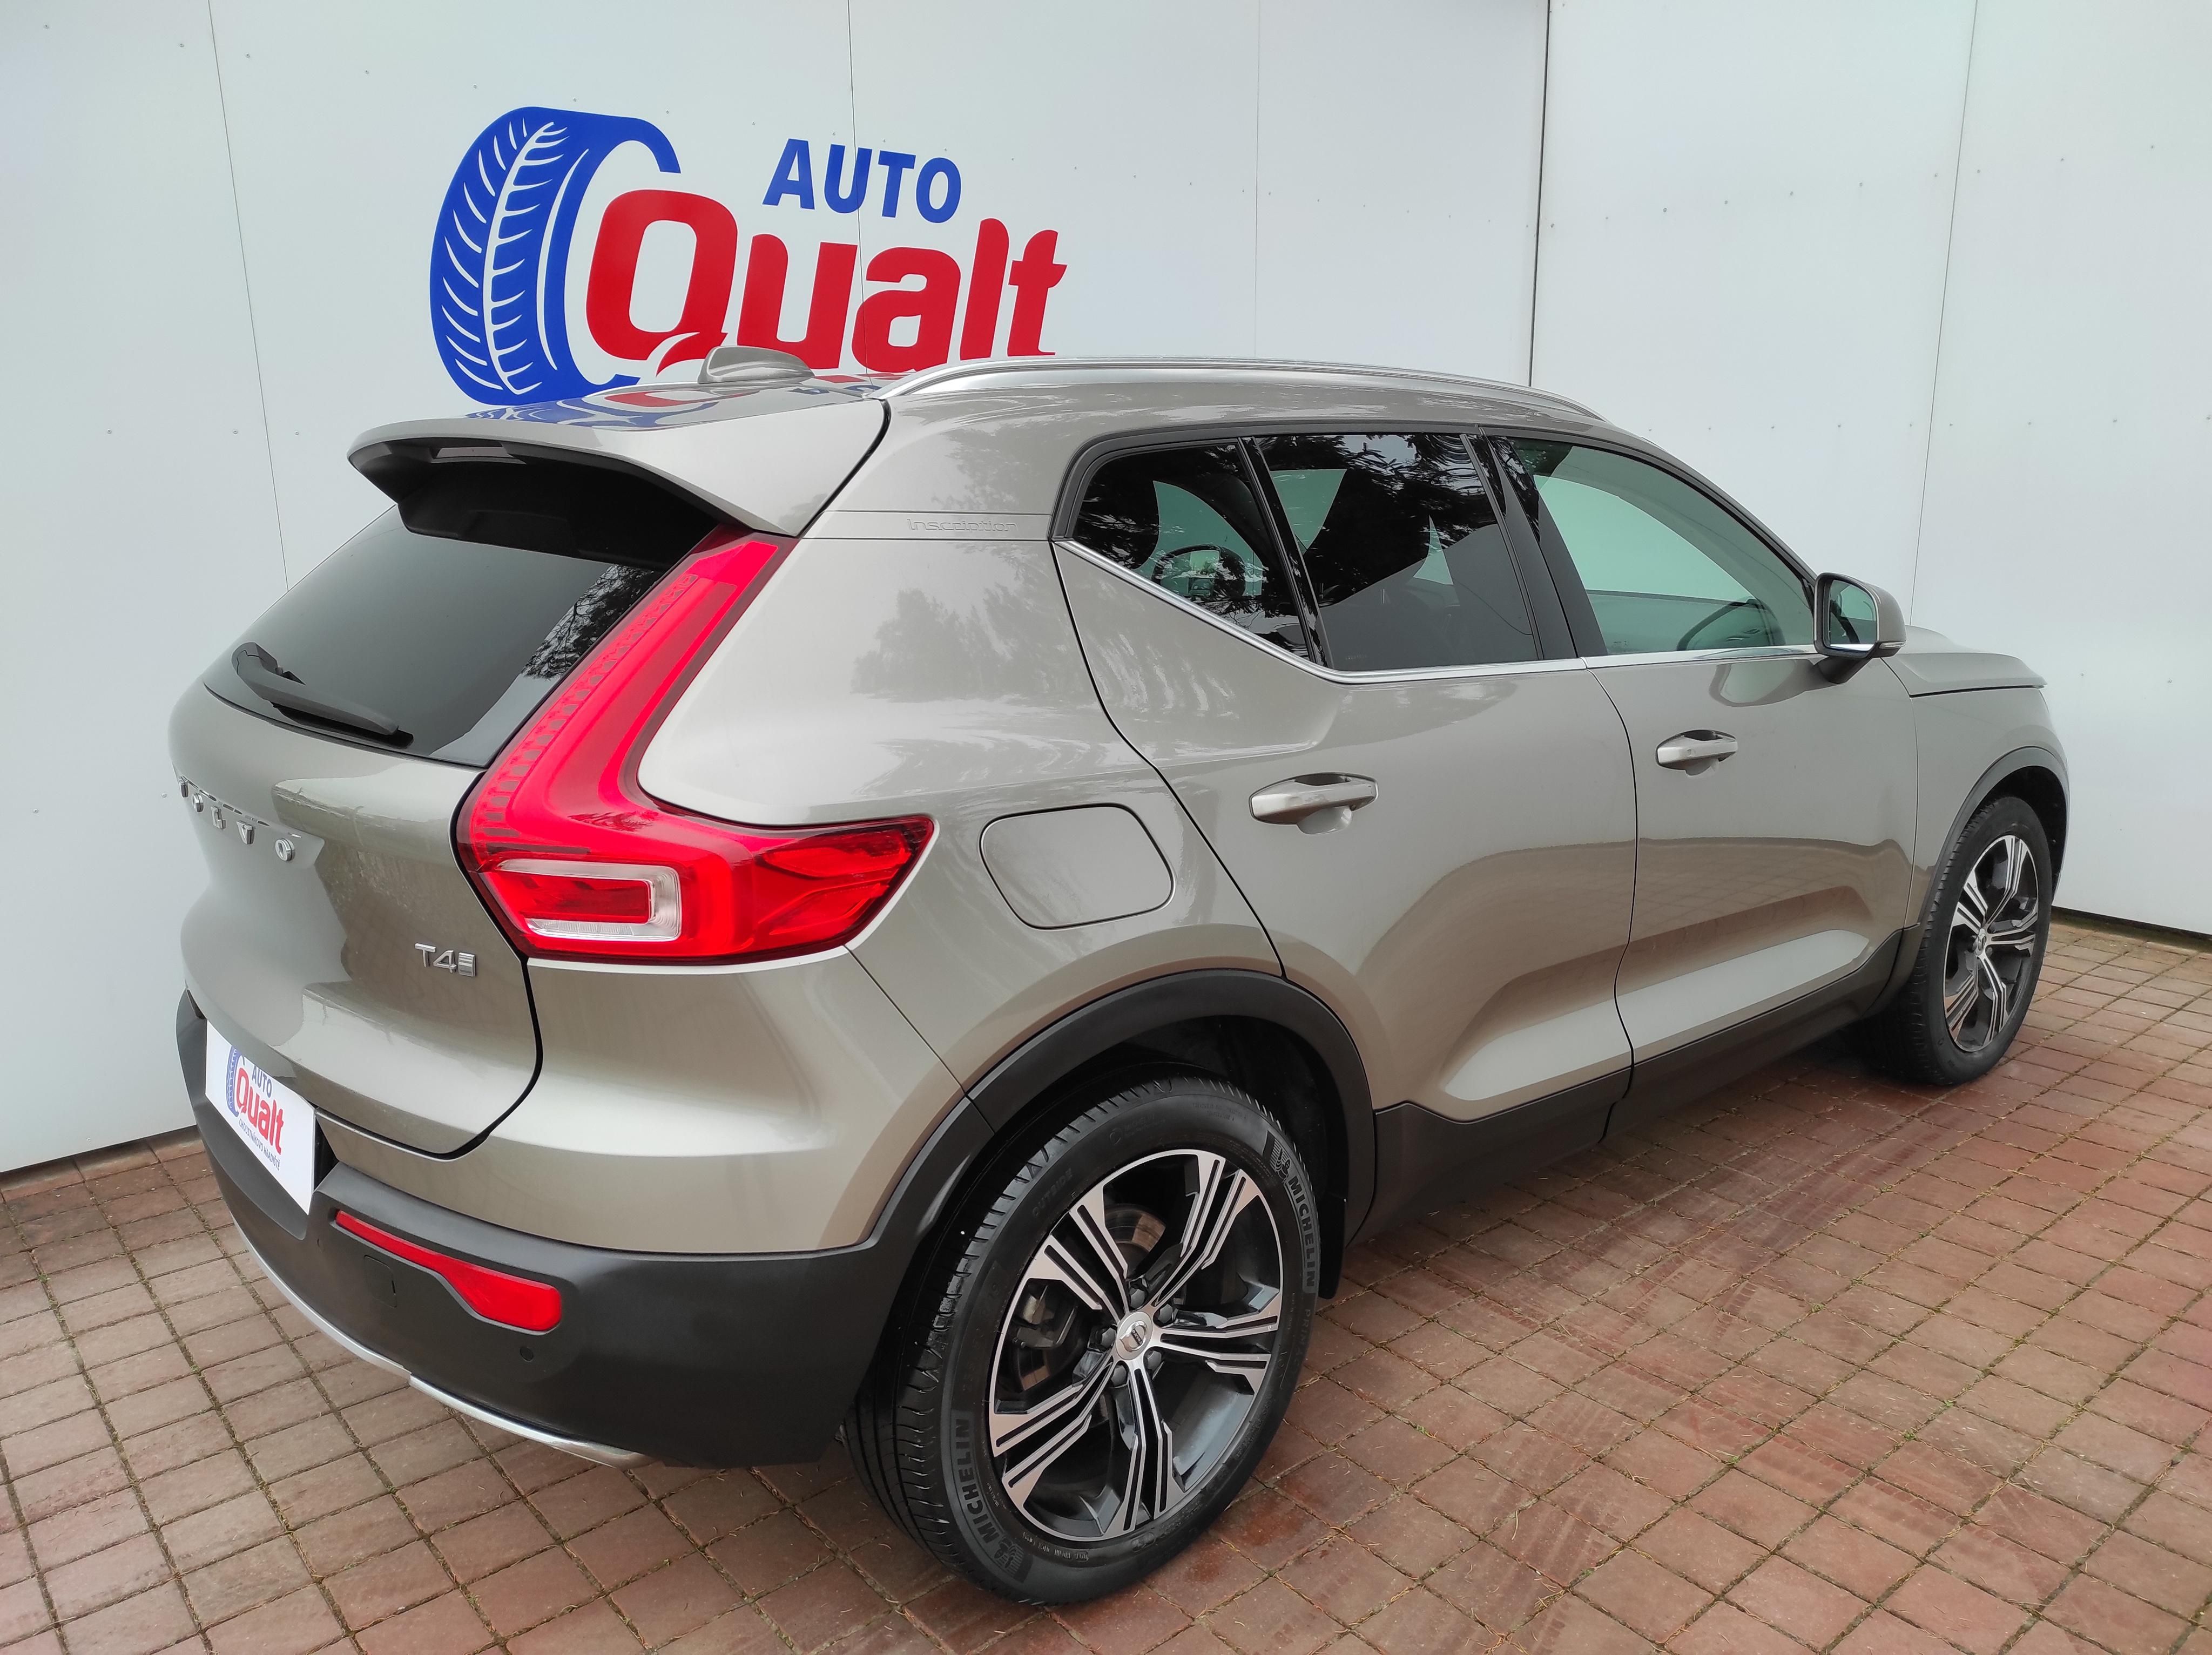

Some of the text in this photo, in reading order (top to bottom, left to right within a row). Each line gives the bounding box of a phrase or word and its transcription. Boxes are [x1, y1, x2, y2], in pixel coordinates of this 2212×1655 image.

[763, 138, 961, 223] AUTO
[586, 190, 1067, 377] Qualt
[907, 518, 1019, 531] Inscription
[236, 1068, 284, 1156] Qualt
[251, 1065, 272, 1098] AUTO
[1287, 1176, 1316, 1287] MICHELIN
[956, 1418, 999, 1543] MICHELIN
